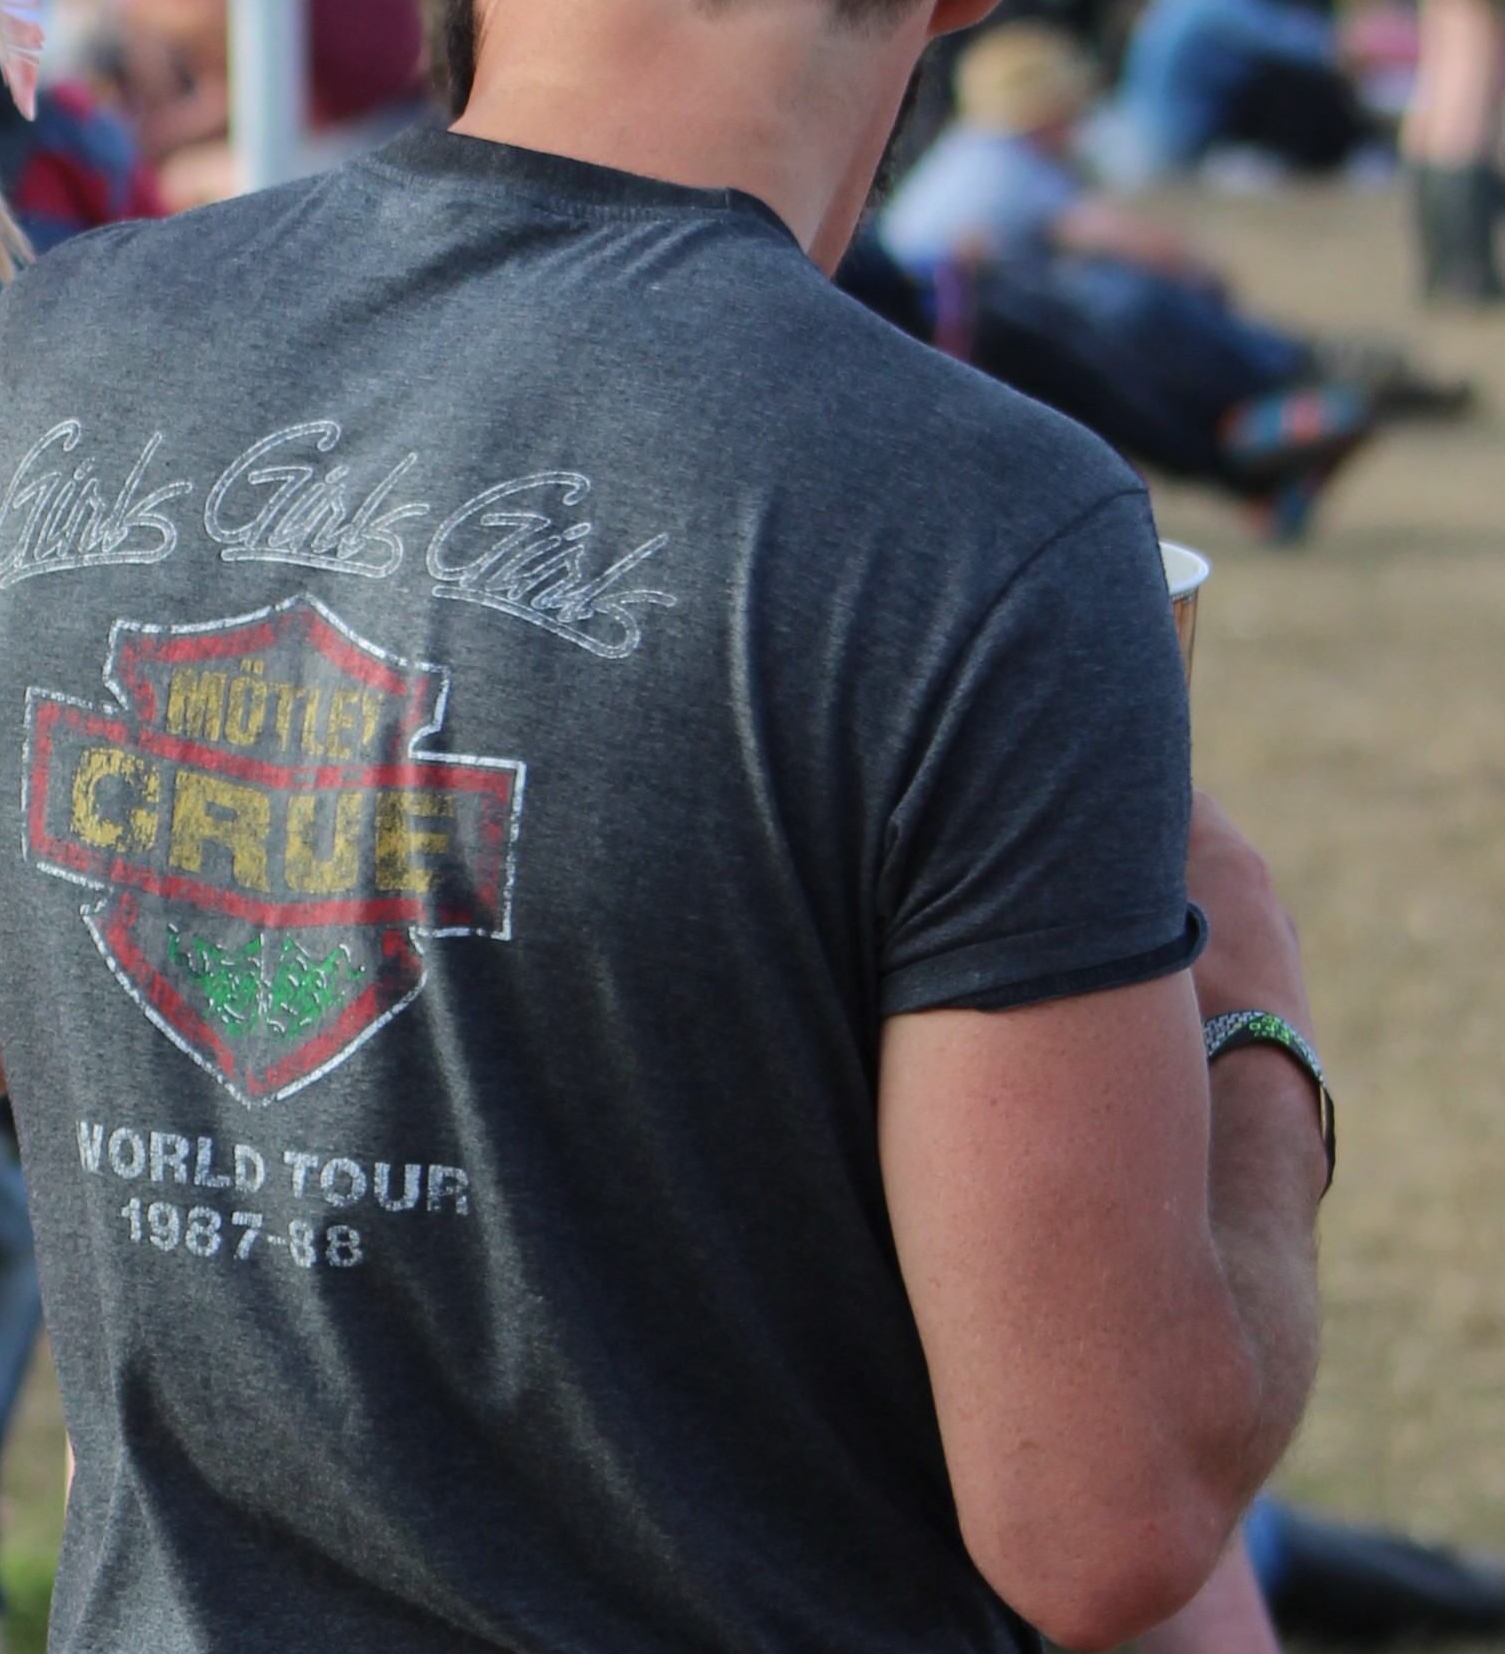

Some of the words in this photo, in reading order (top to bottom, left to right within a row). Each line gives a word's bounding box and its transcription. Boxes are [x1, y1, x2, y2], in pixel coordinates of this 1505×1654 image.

[203, 420, 432, 581] Girls
[426, 469, 677, 659] Girls
[76, 1119, 265, 1195] WORLD
[284, 1150, 471, 1216] TOUR
[120, 1197, 365, 1270] 1987-88
